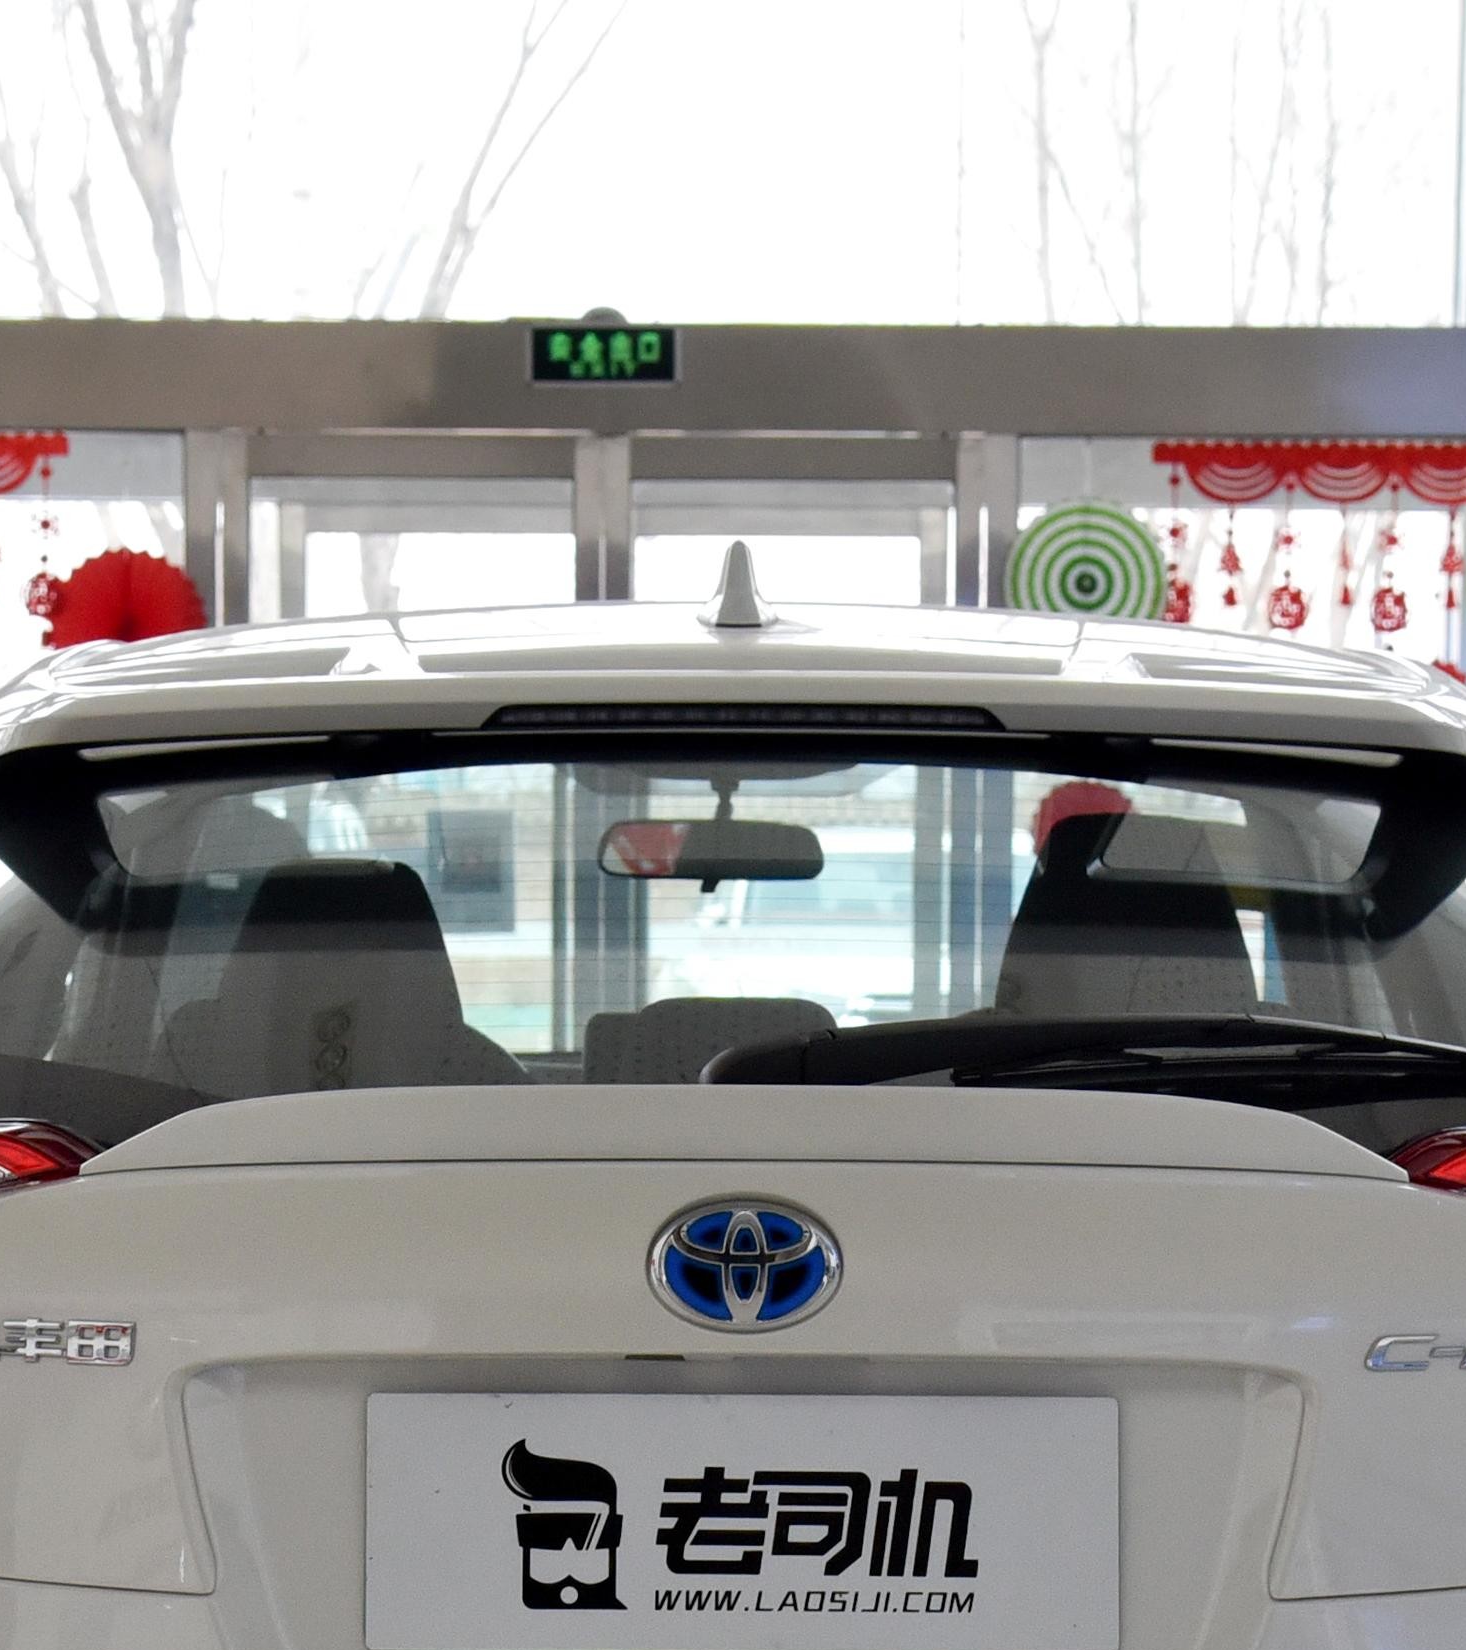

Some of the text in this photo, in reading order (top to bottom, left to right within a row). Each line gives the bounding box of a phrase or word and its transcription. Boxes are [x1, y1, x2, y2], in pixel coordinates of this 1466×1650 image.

[655, 1466, 980, 1579] 老司机
[653, 1589, 976, 1615] WWW.LAOSIJI.COM
